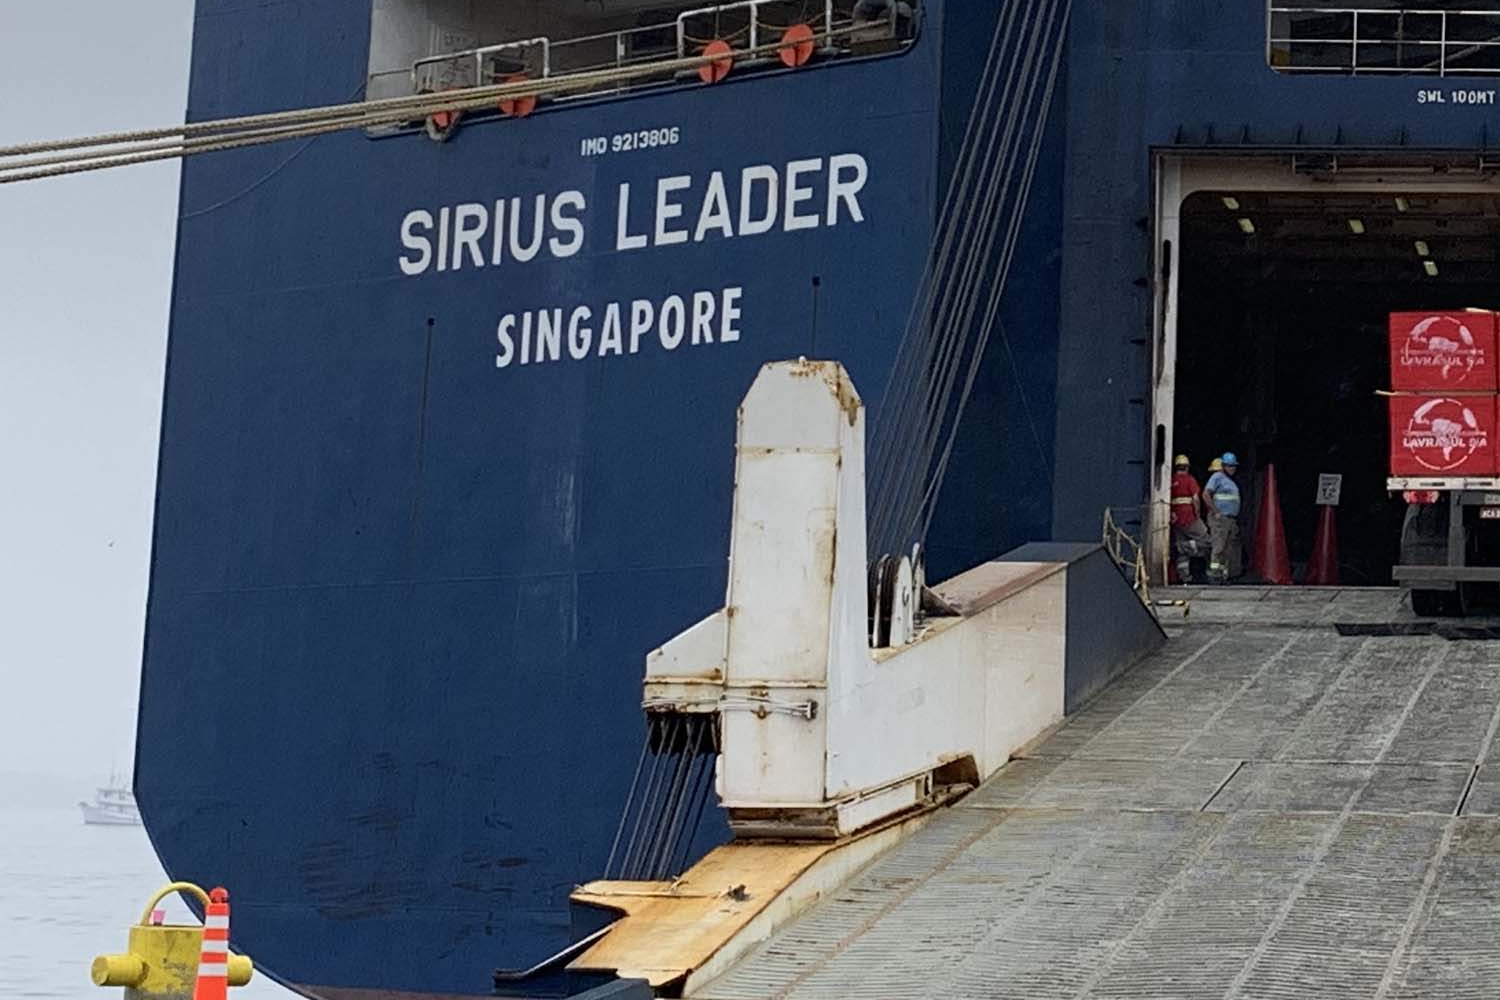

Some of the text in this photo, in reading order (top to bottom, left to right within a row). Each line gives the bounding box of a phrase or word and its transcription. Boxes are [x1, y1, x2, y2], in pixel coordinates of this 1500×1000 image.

[1417, 89, 1496, 104] SWL 100MT
[581, 127, 680, 156] IMO 9213806
[398, 152, 868, 276] SIRIUS LEADER
[496, 287, 743, 368] SINGAPORE
